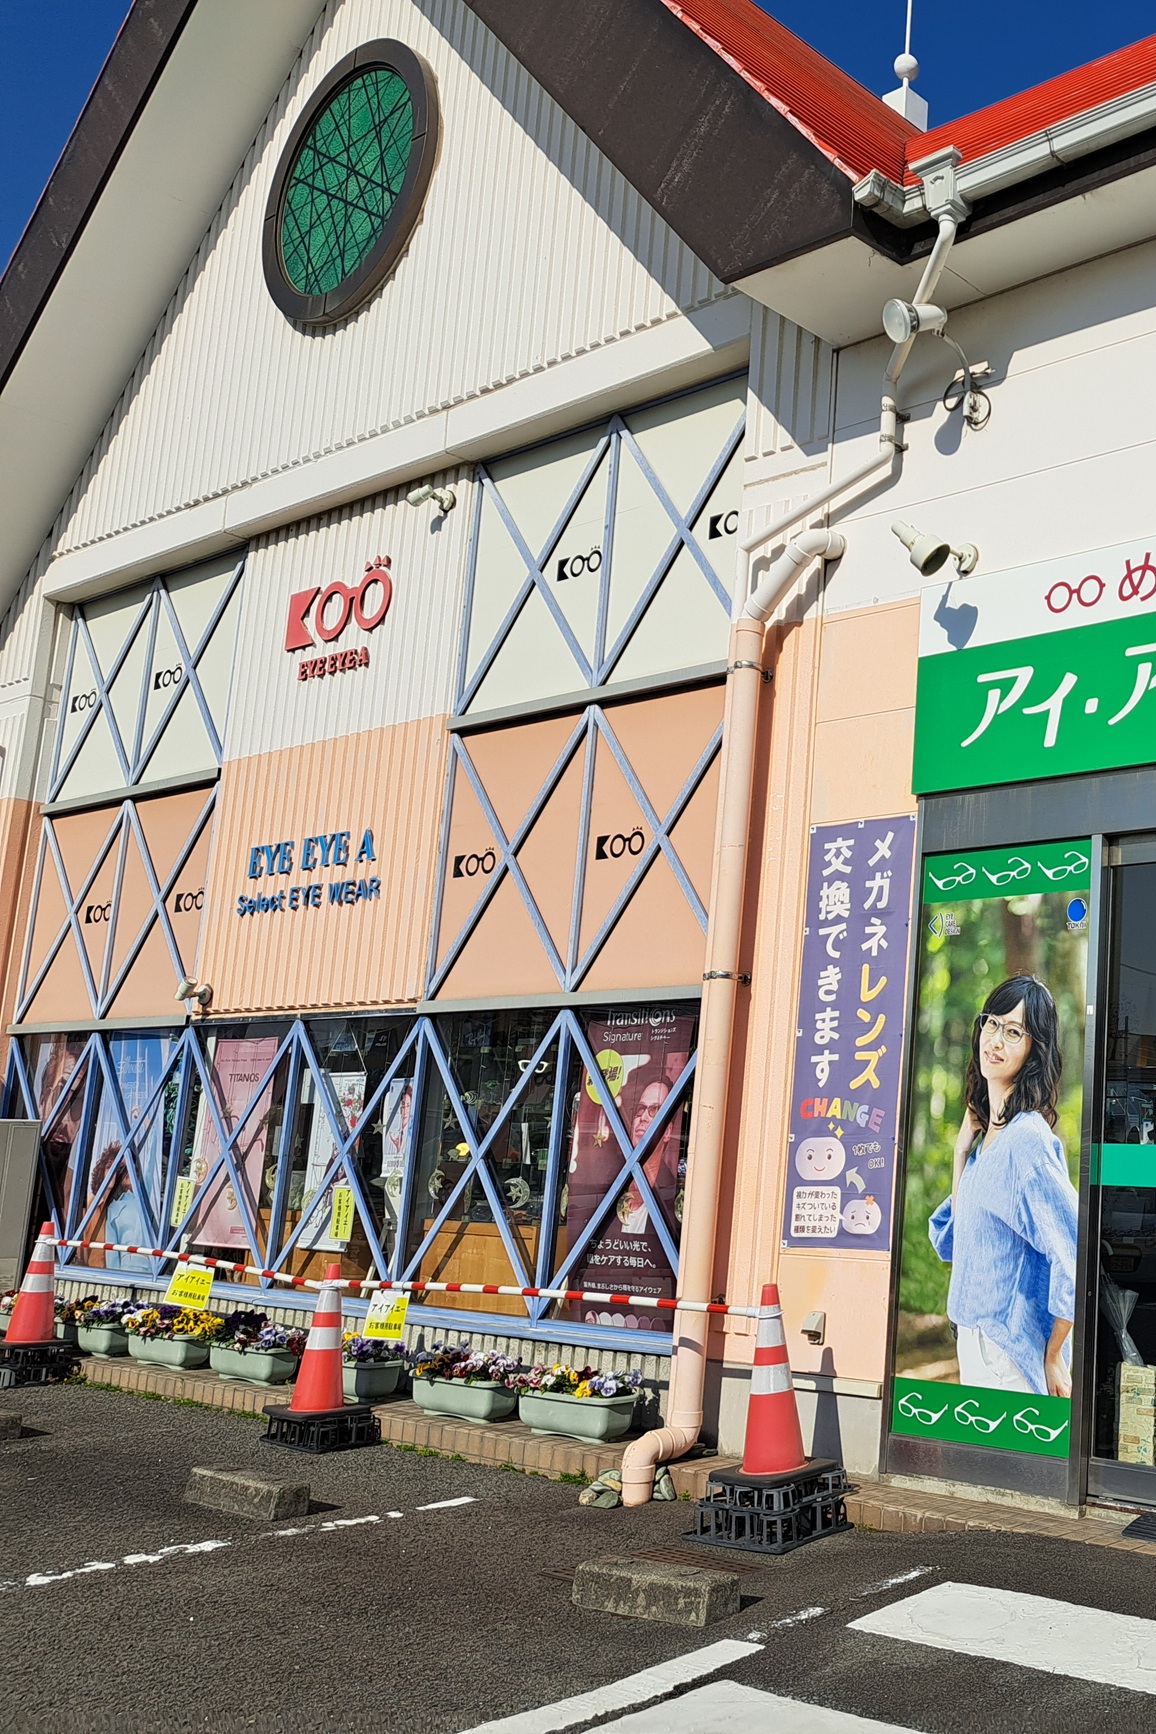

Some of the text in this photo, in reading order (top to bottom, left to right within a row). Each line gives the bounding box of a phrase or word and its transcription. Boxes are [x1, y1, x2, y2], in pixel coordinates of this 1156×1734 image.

[298, 646, 370, 681] EYE EYE A
[247, 827, 376, 879] EYE EYE A
[237, 876, 381, 917] Select EYE WEAR
[810, 836, 855, 1089] 交換できます
[849, 830, 895, 1091] メガネレンズ
[606, 1008, 676, 1027] Transitions
[603, 1031, 643, 1044] Signature
[800, 1097, 886, 1134] CHANGE
[852, 1140, 882, 1156] 1枚でも
[868, 1157, 885, 1169] OK!
[795, 1202, 837, 1211] キズついている
